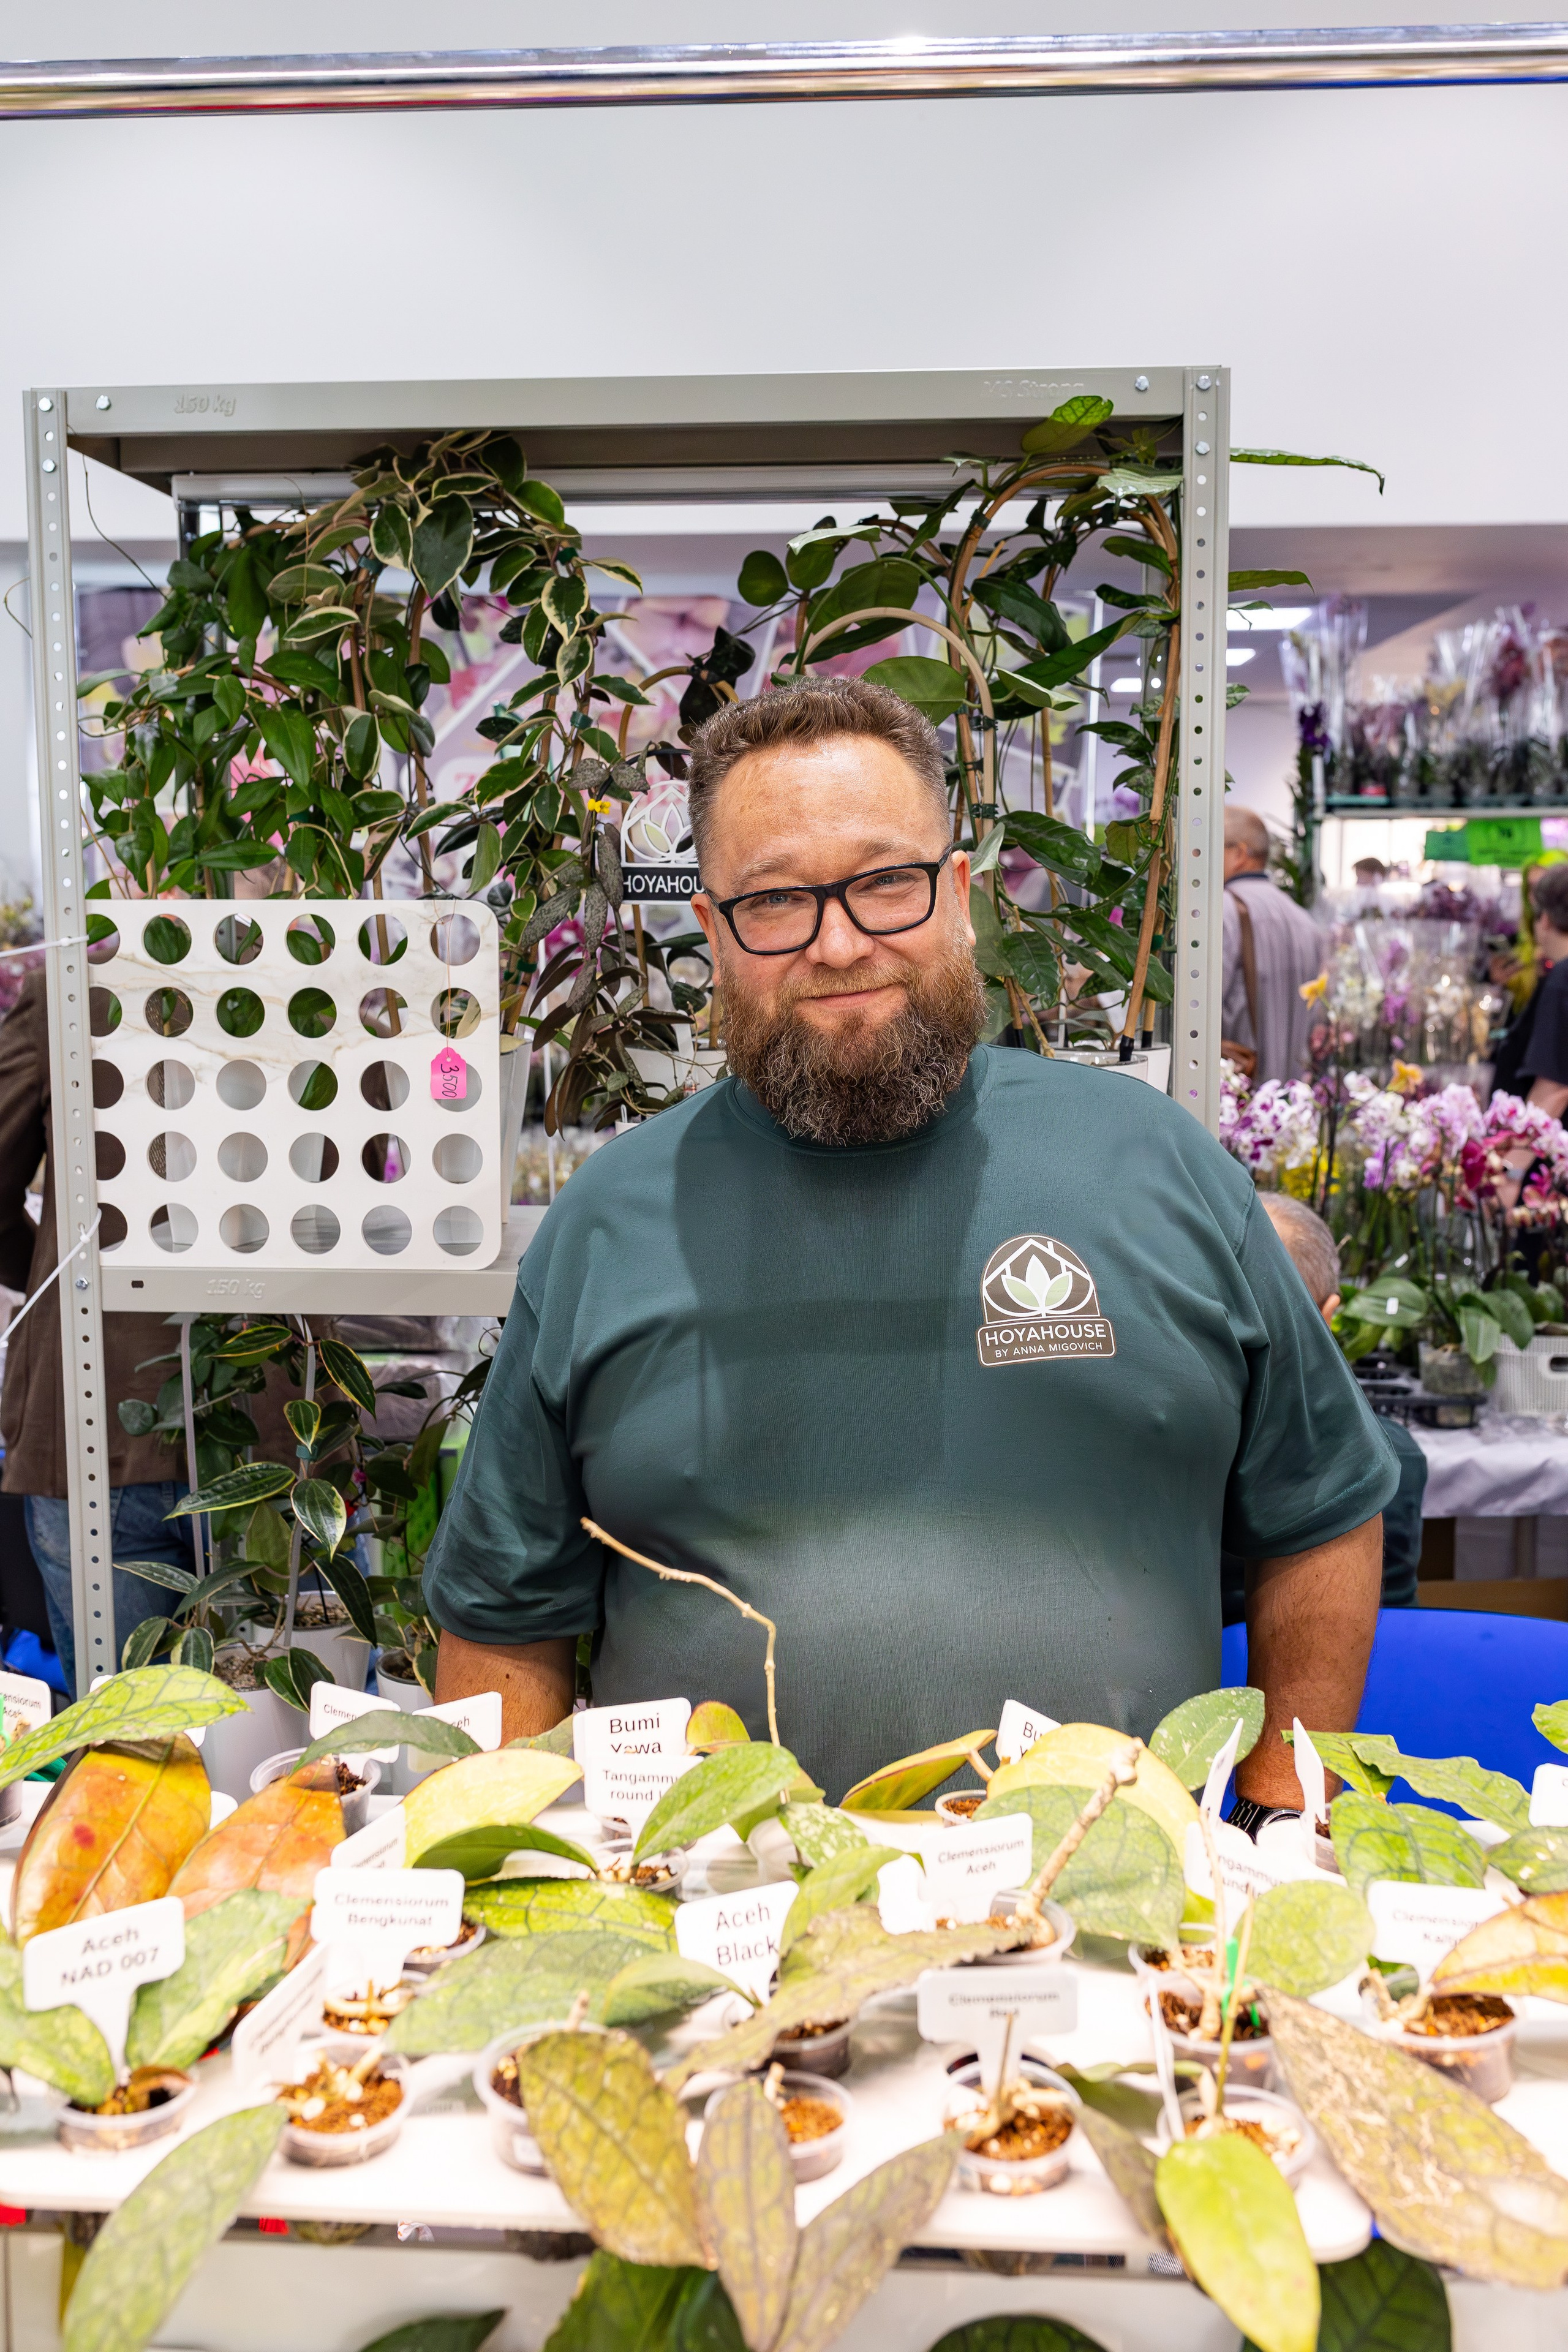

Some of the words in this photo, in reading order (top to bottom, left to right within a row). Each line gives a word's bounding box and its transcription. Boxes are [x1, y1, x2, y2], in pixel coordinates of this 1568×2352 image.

[175, 394, 209, 414] 150
[214, 394, 236, 418] kg
[440, 1063, 460, 1098] 3500
[206, 1278, 240, 1295] 150
[243, 1278, 265, 1299] kg
[984, 1323, 1107, 1347] HOYAHOUSE
[995, 1349, 1009, 1359] BY
[1012, 1344, 1046, 1355] ANNA
[1049, 1342, 1103, 1352] MIGOVICH
[609, 1713, 660, 1734] Bumi
[610, 1789, 654, 1801] round
[716, 1902, 771, 1931] Aceh
[81, 1928, 139, 1954] Aceh
[717, 1936, 780, 1966] Black
[61, 1959, 113, 1986] NAD
[119, 1947, 159, 1970] 007
